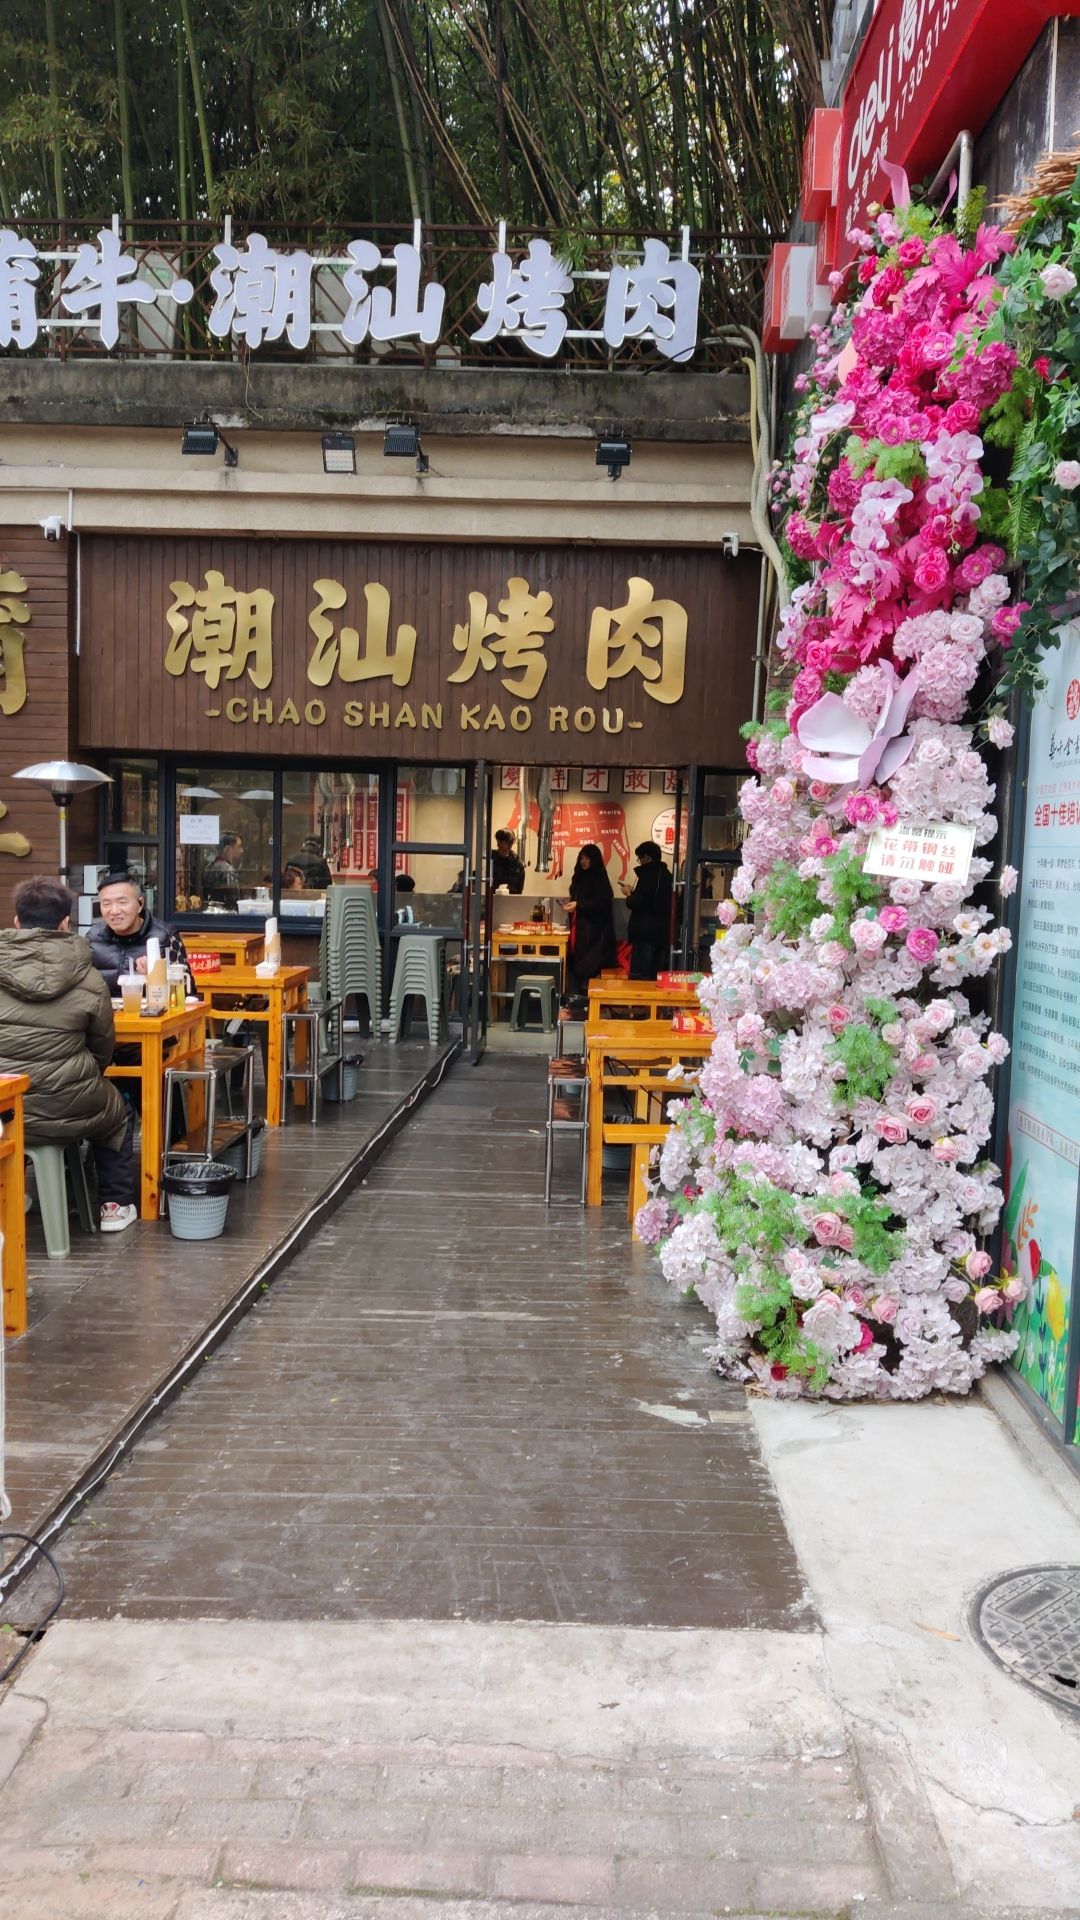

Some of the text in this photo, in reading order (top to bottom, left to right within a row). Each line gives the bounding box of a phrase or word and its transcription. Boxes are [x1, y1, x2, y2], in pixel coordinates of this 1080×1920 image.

[164, 570, 690, 705] 潮汕烤肉
[343, 701, 445, 731] SHAN
[460, 704, 533, 733] KAO
[884, 837, 957, 858] 花带钢丝
[881, 853, 955, 875] 请勿触碰
